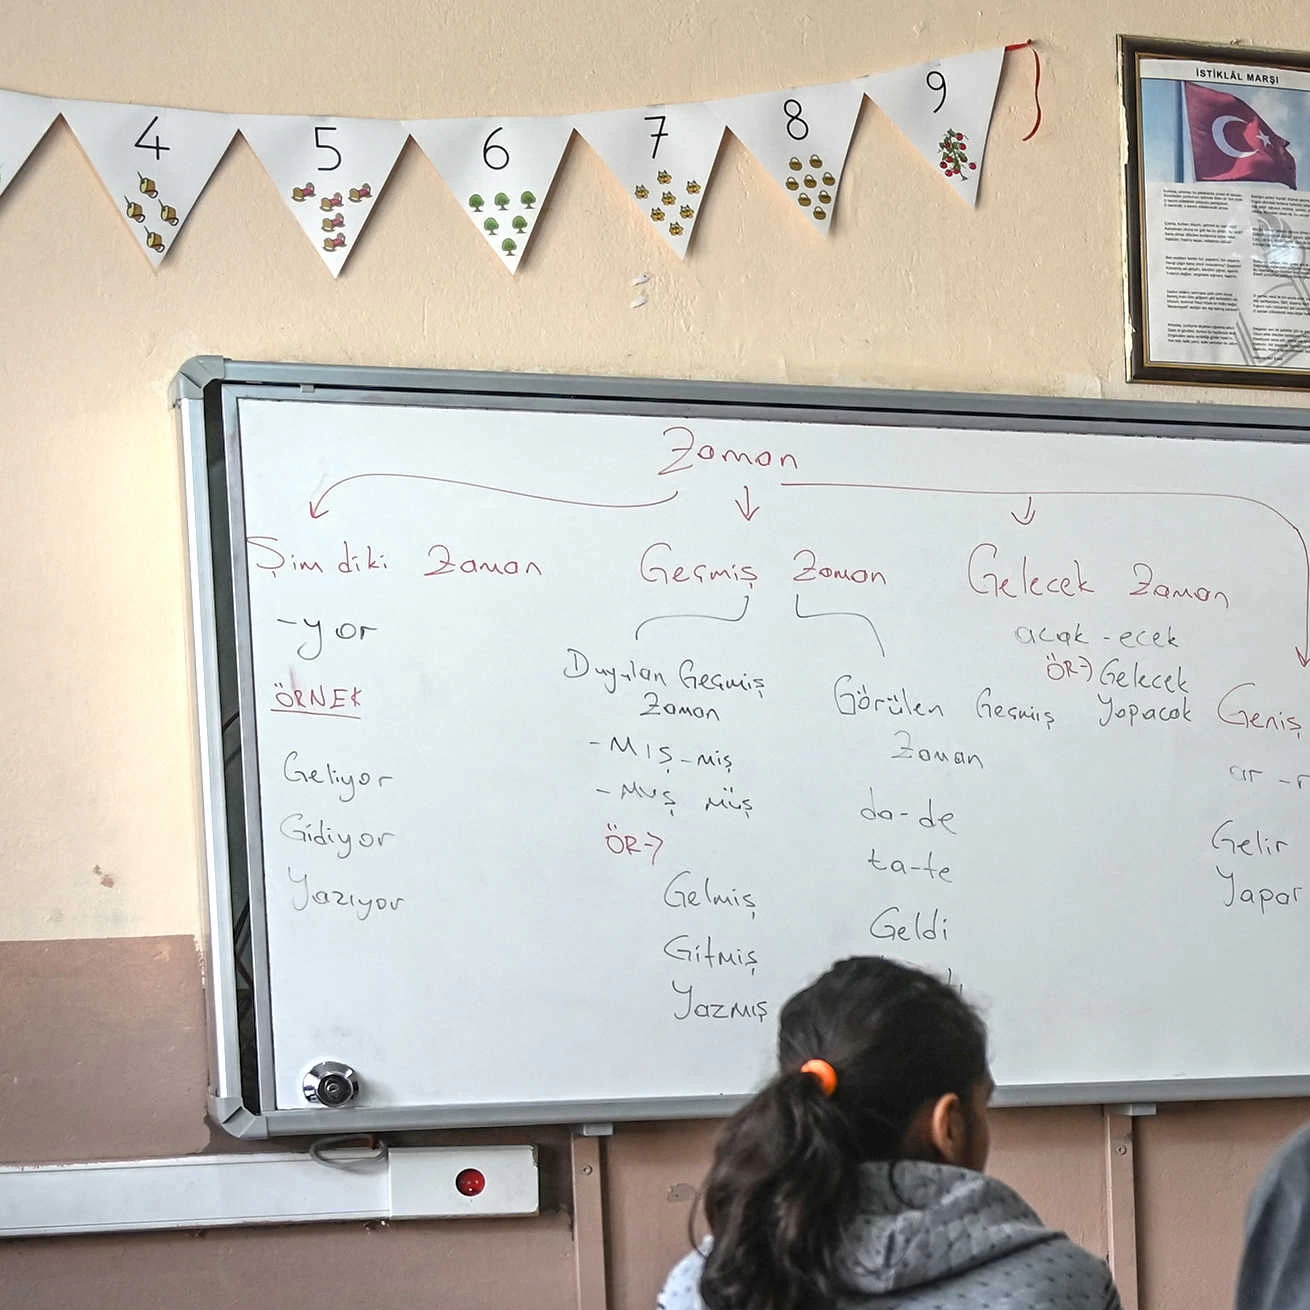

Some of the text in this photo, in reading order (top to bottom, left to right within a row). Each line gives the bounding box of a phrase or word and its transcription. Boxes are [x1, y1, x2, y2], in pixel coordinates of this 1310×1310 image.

[926, 71, 946, 113] 9
[1196, 68, 1278, 84] İSTİKLÂL MARŞI
[134, 116, 170, 160] 4
[644, 116, 668, 159] 7
[784, 99, 808, 140] 8
[315, 127, 341, 171] 5
[483, 127, 509, 170] 6
[658, 426, 797, 475] Zaman
[424, 545, 542, 576] Zaman
[641, 543, 886, 589] Geçmiş Zaman
[968, 543, 1229, 608] Gelecek Zaman
[274, 681, 361, 709] ÖRNEK
[679, 659, 764, 698] Geçmiş
[834, 675, 943, 716] Görülen
[1100, 658, 1189, 693] Gelecek
[640, 692, 720, 721] Zaman
[1217, 683, 1302, 739] Geniş
[891, 730, 983, 768] Zaman
[284, 751, 392, 802] Geliyor
[280, 813, 394, 859] Gidiyor
[1212, 820, 1288, 856] Gelir
[288, 867, 404, 920] Yazıyor
[664, 871, 755, 920] Gelmiş
[1216, 865, 1302, 914] Yapar
[870, 907, 947, 941] Geldi
[664, 935, 757, 976] Gitmiş
